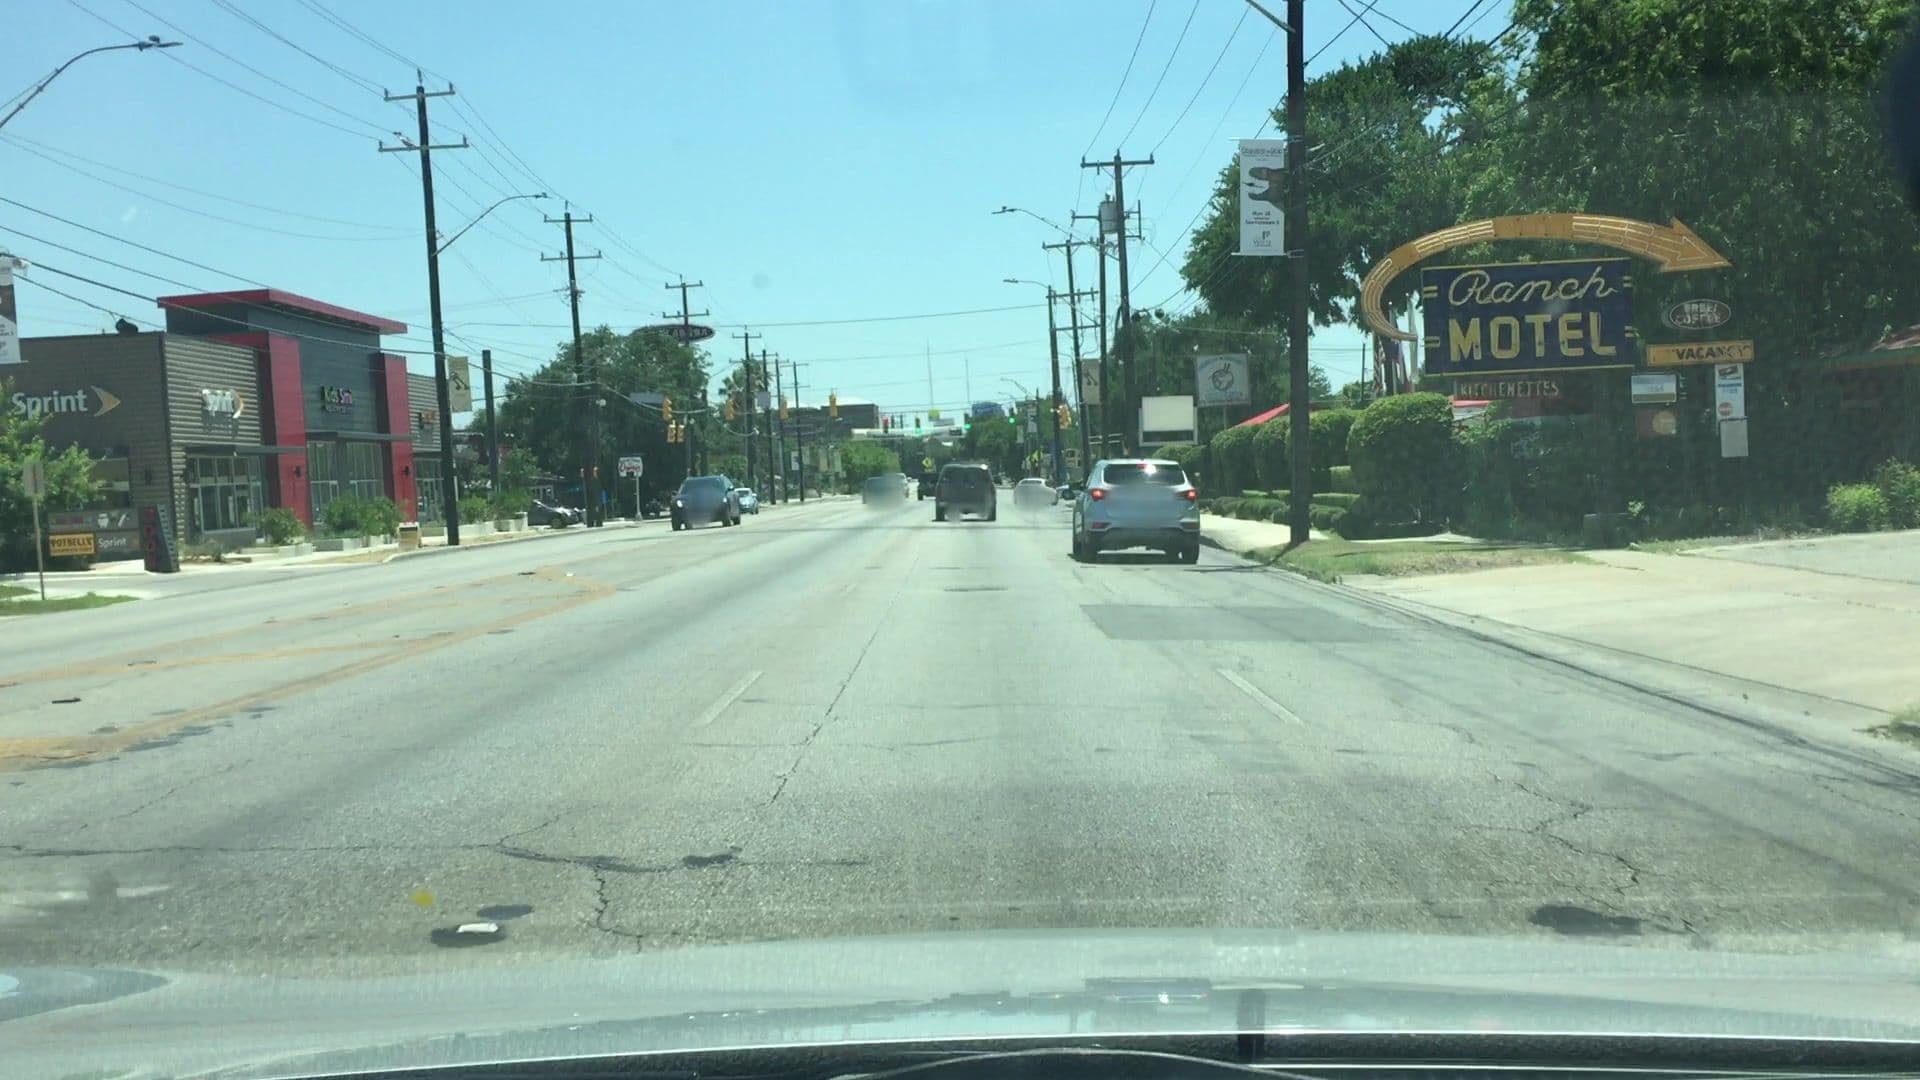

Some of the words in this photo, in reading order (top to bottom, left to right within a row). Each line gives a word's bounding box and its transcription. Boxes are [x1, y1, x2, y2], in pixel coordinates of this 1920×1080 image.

[1448, 265, 1619, 307] Ranch
[1448, 311, 1617, 363] MOTEL
[1676, 345, 1750, 360] VACANCY
[1460, 379, 1560, 398] KITCHENETTES
[11, 389, 89, 420] Sprint
[51, 537, 93, 548] POTBELLY
[97, 537, 127, 548] Sprint
